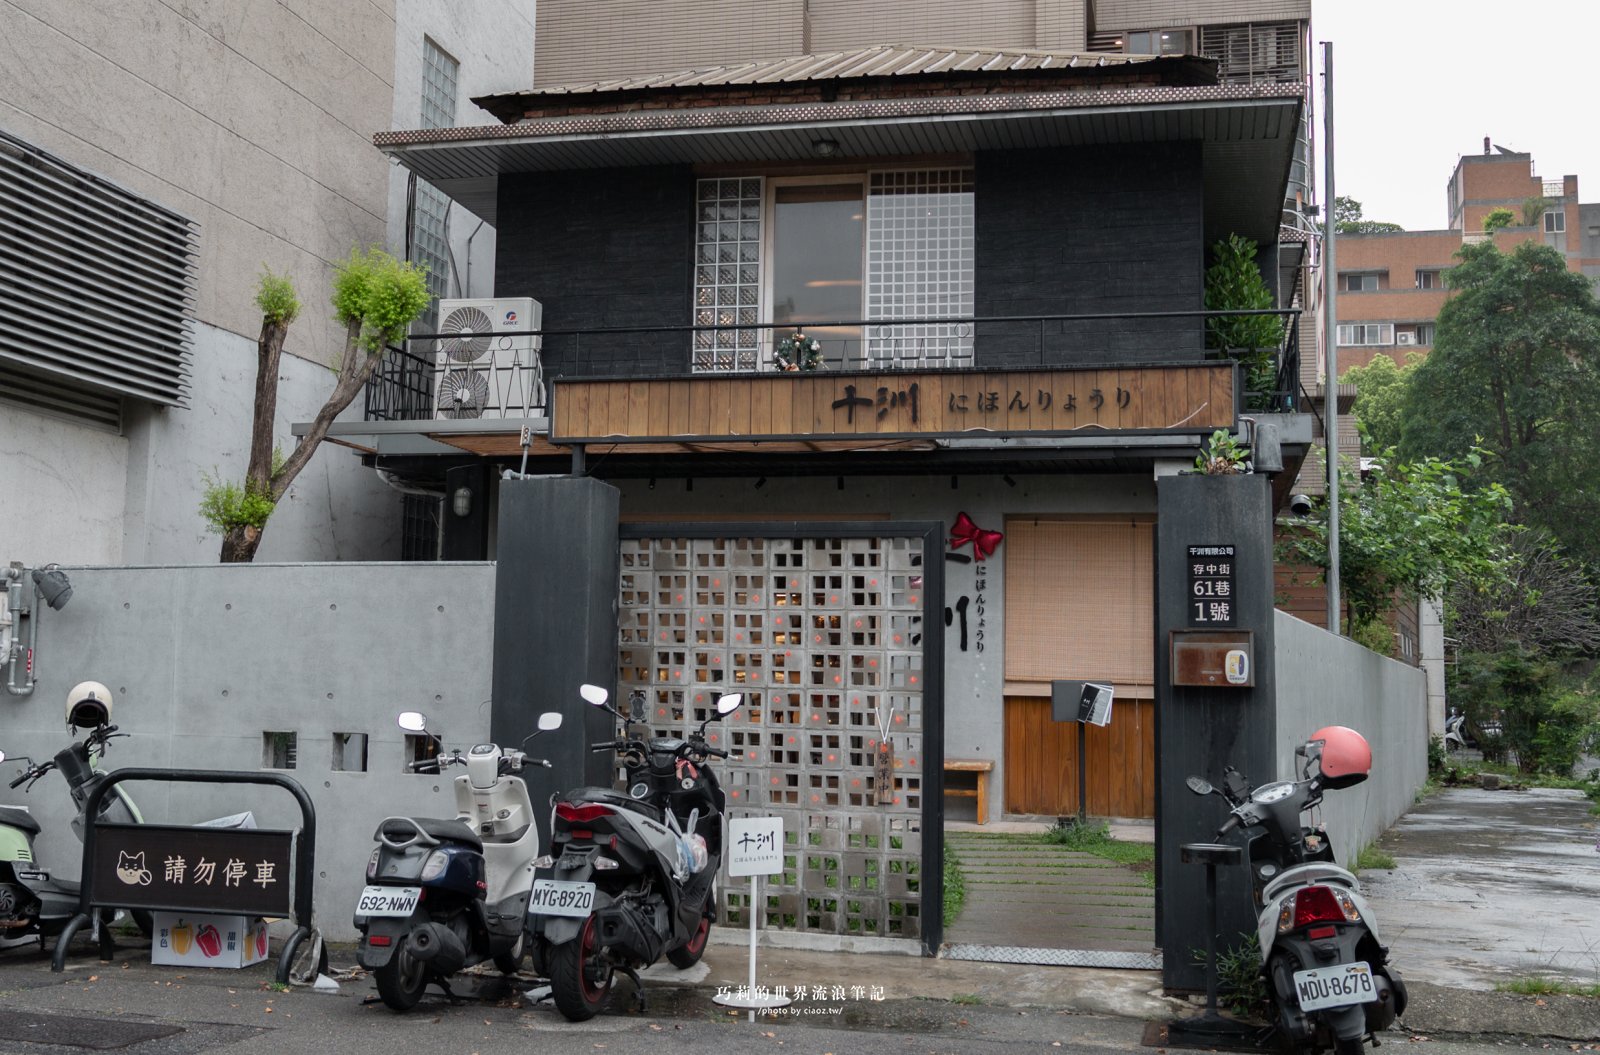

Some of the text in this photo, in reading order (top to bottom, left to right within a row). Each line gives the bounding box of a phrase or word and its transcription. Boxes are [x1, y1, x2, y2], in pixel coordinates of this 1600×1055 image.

[949, 387, 1131, 413] にほんりょうり
[1193, 563, 1231, 575] 存中街
[1193, 580, 1231, 596] 61巷
[975, 565, 987, 653] にほんりょうり
[1194, 601, 1230, 622] 1號
[163, 855, 277, 889] 請勿停車
